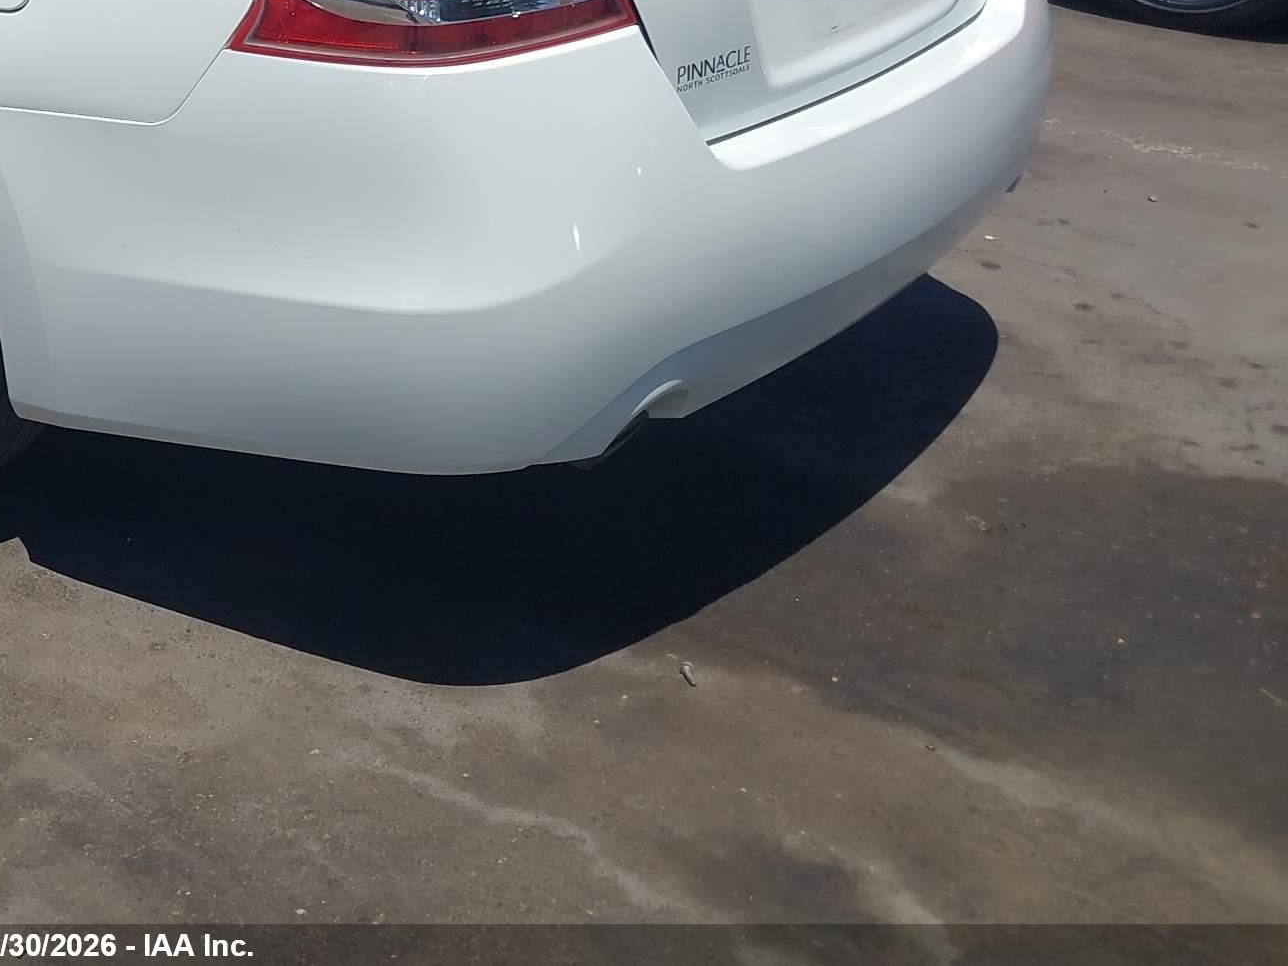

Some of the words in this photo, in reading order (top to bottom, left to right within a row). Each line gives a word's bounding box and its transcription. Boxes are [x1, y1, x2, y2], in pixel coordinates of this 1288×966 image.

[676, 45, 751, 85] PINNACLE
[676, 80, 703, 94] NORTH
[706, 64, 750, 84] SCOTTSDALE
